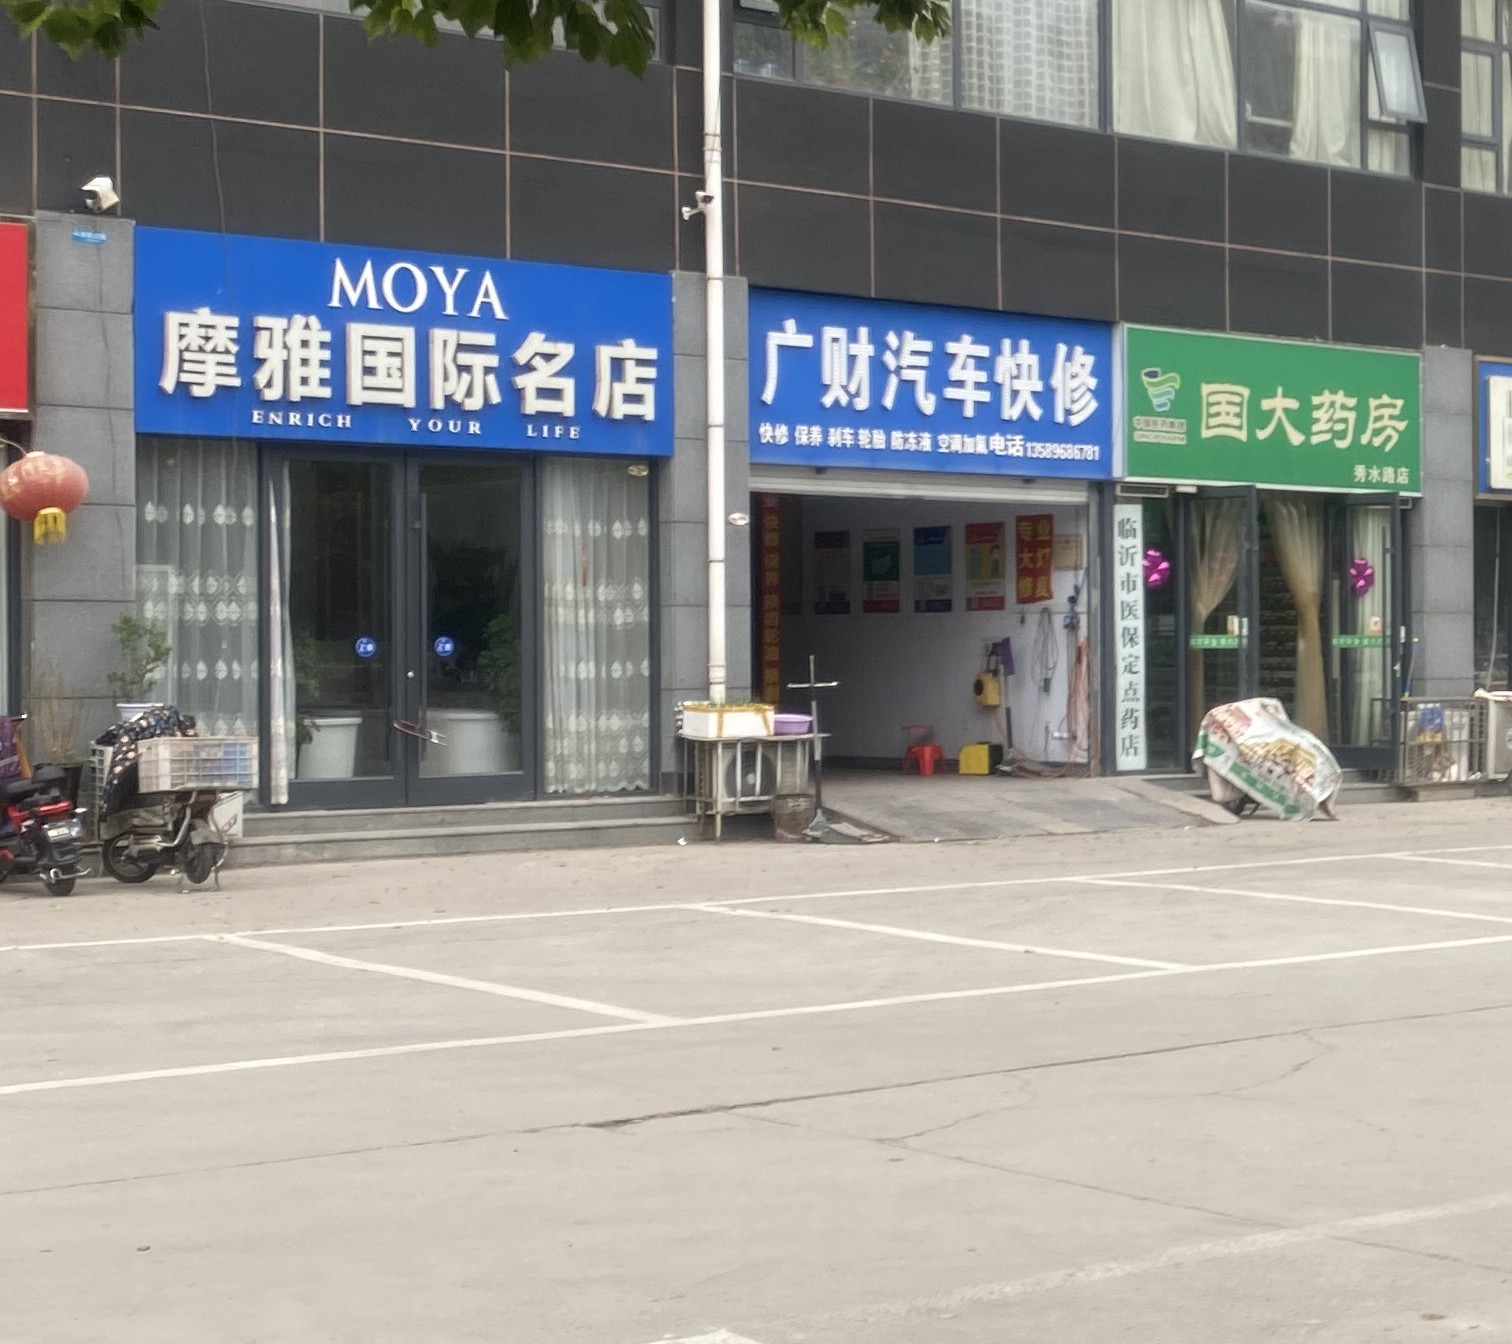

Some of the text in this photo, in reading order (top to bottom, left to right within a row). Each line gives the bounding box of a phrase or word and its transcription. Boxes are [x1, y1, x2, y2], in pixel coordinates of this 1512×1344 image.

[328, 257, 509, 321] MOYA
[159, 306, 659, 422] 摩雅国际名店
[761, 319, 1099, 427] 广财汽车快修
[251, 409, 583, 441] ENRICH YOUR LIFE
[1200, 381, 1409, 453] 国大药房
[1353, 464, 1410, 485] 秀水路店
[1116, 516, 1142, 758] 临沂市医保定点药店
